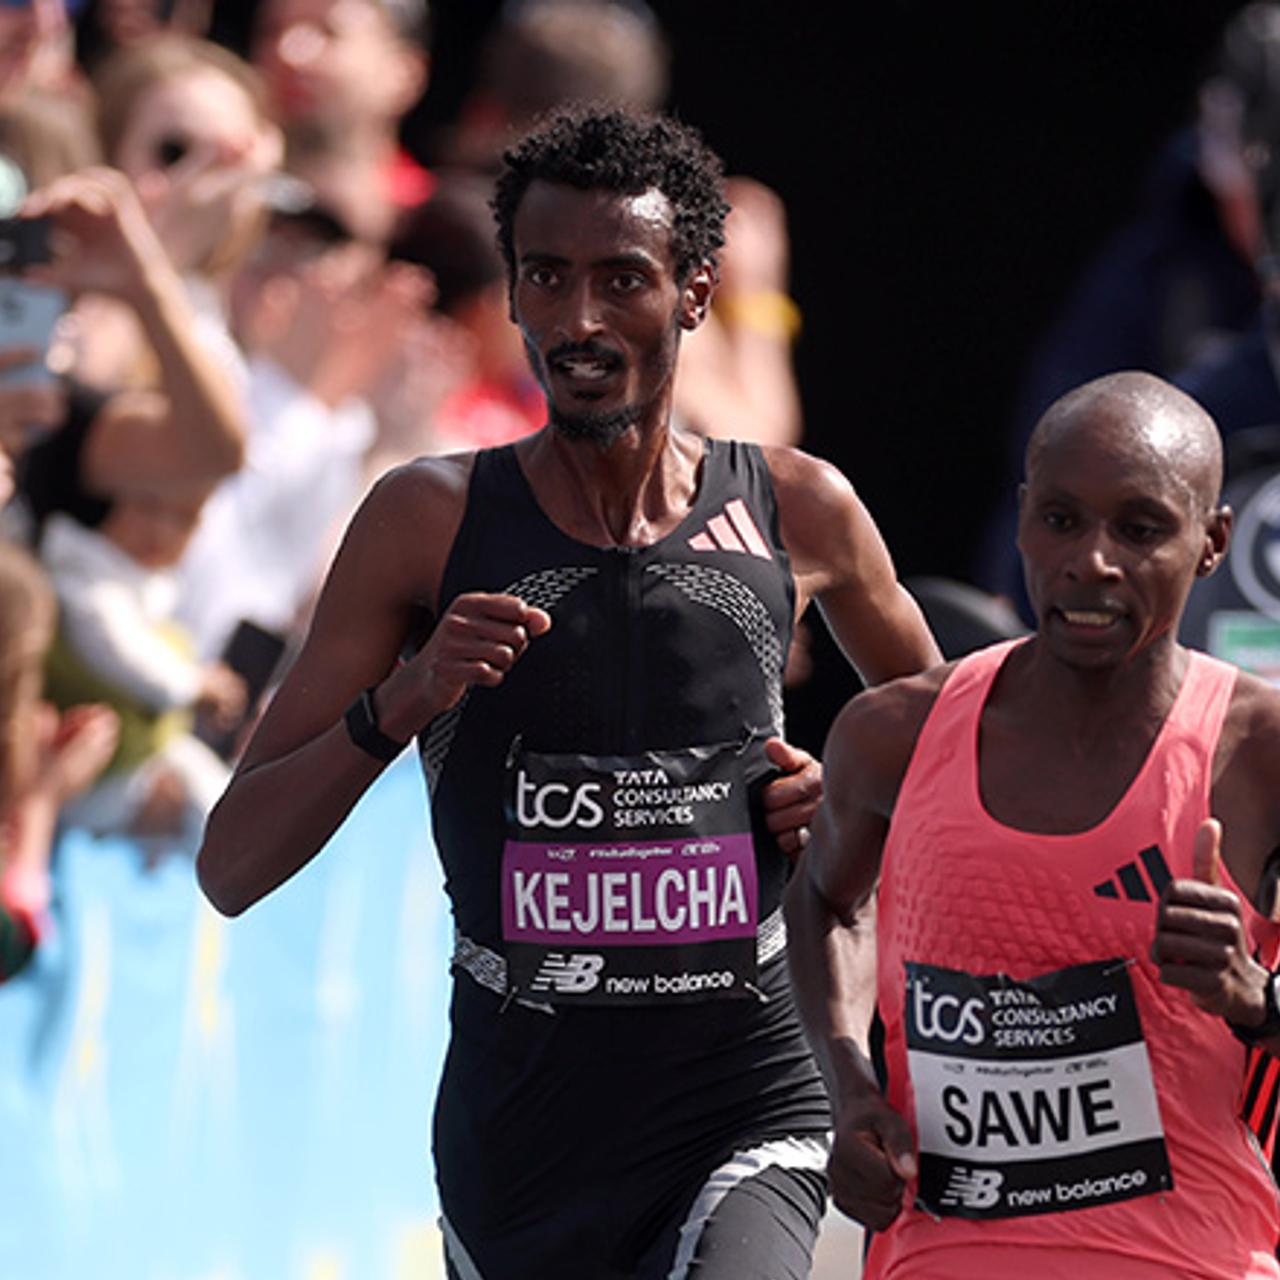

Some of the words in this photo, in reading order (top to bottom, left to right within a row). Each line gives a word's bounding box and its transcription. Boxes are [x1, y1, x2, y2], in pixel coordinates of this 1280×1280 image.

[613, 769, 669, 785] TATA
[517, 770, 604, 828] tcs
[613, 782, 732, 806] CONSULTANCY
[613, 805, 695, 828] SERVICES
[513, 864, 749, 933] KEJELCHA
[605, 976, 650, 993] new
[653, 970, 735, 993] balance
[915, 980, 985, 1045] tcs
[991, 994, 1118, 1026] CONSULTANCY
[993, 1026, 1076, 1047] SERVICES
[942, 1079, 1120, 1148] SAWE
[1007, 1188, 1051, 1207] new
[1055, 1169, 1148, 1201] balance
